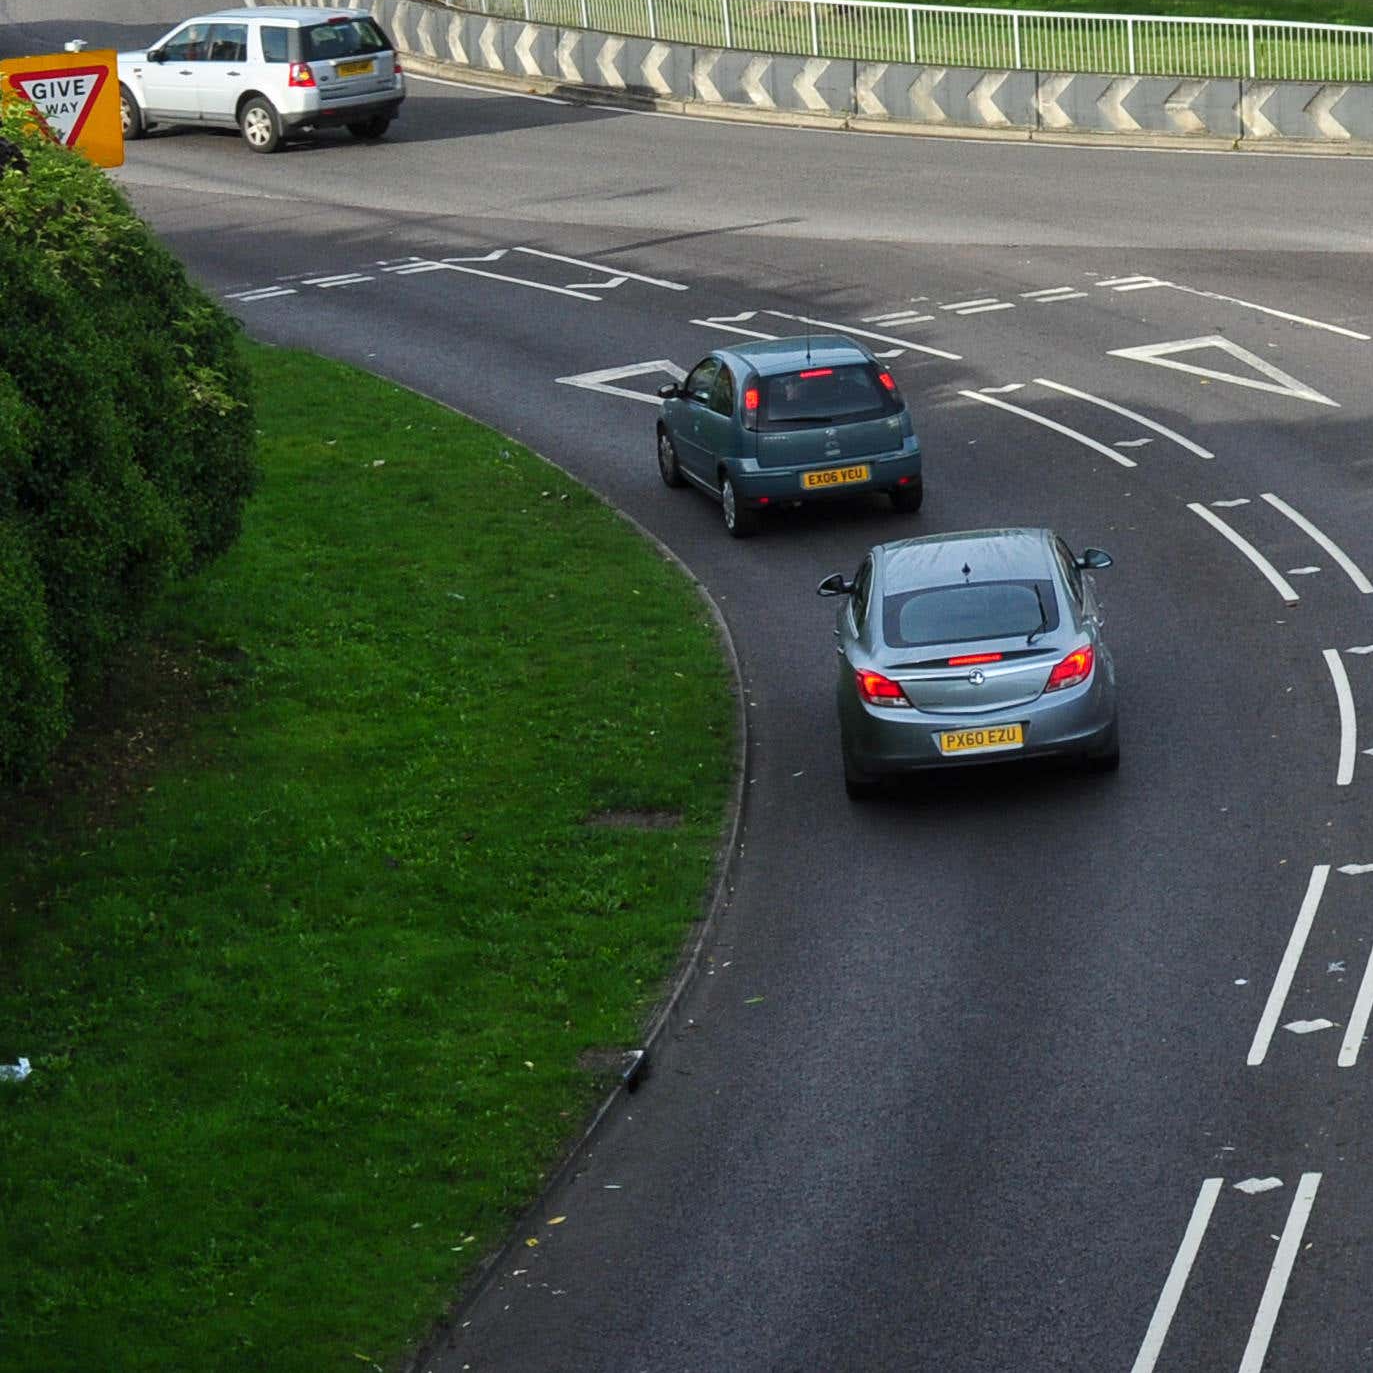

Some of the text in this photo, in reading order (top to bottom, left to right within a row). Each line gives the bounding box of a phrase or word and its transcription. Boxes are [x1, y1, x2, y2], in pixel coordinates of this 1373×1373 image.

[31, 79, 86, 100] GIVE
[45, 101, 78, 115] WAY
[807, 472, 838, 486] EX06
[946, 728, 1016, 748] PX60 EZU
